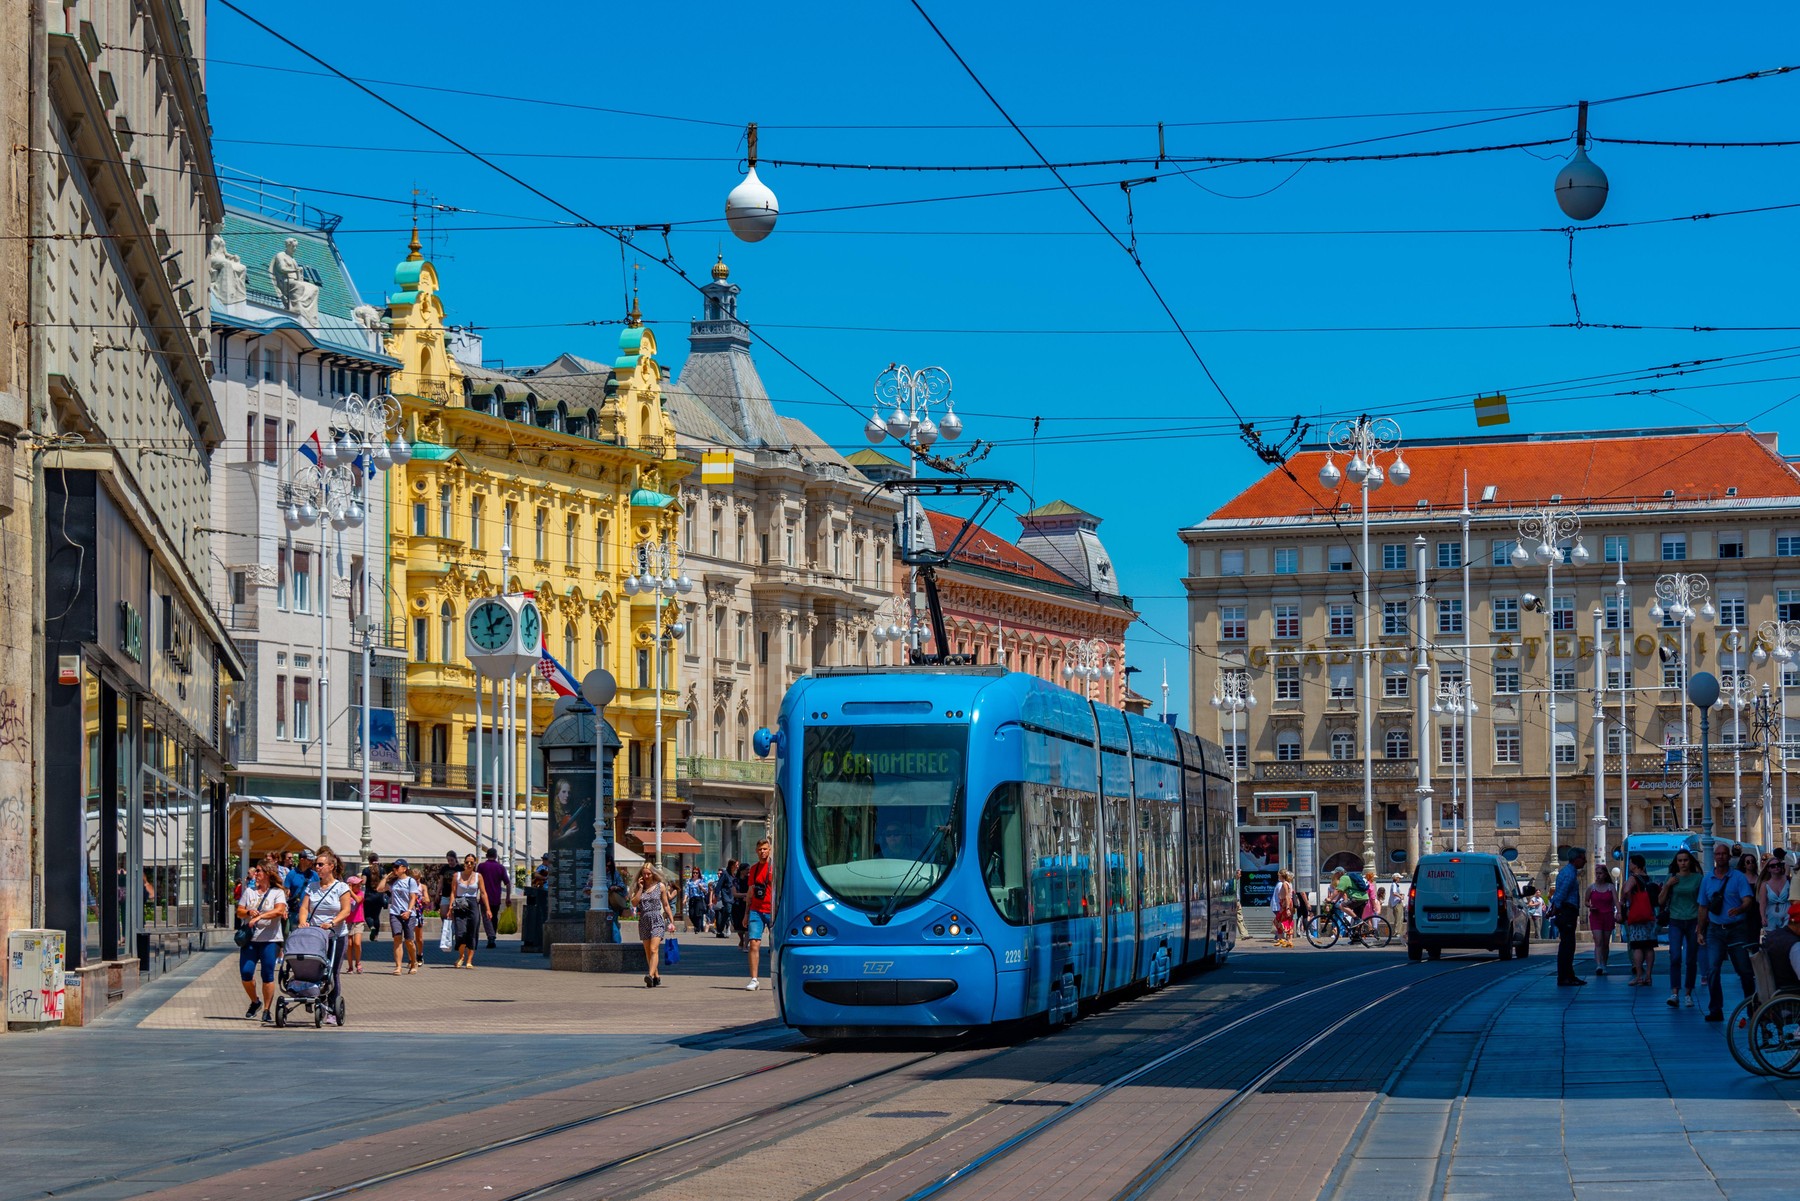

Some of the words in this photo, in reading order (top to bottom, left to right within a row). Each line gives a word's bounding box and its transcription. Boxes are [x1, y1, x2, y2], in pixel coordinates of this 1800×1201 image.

[371, 750, 399, 760] OURS
[823, 752, 834, 774] 6
[1427, 870, 1455, 878] ATLANTIC
[1005, 950, 1022, 964] 2229
[802, 964, 829, 974] 2229
[863, 961, 894, 974] ZET
